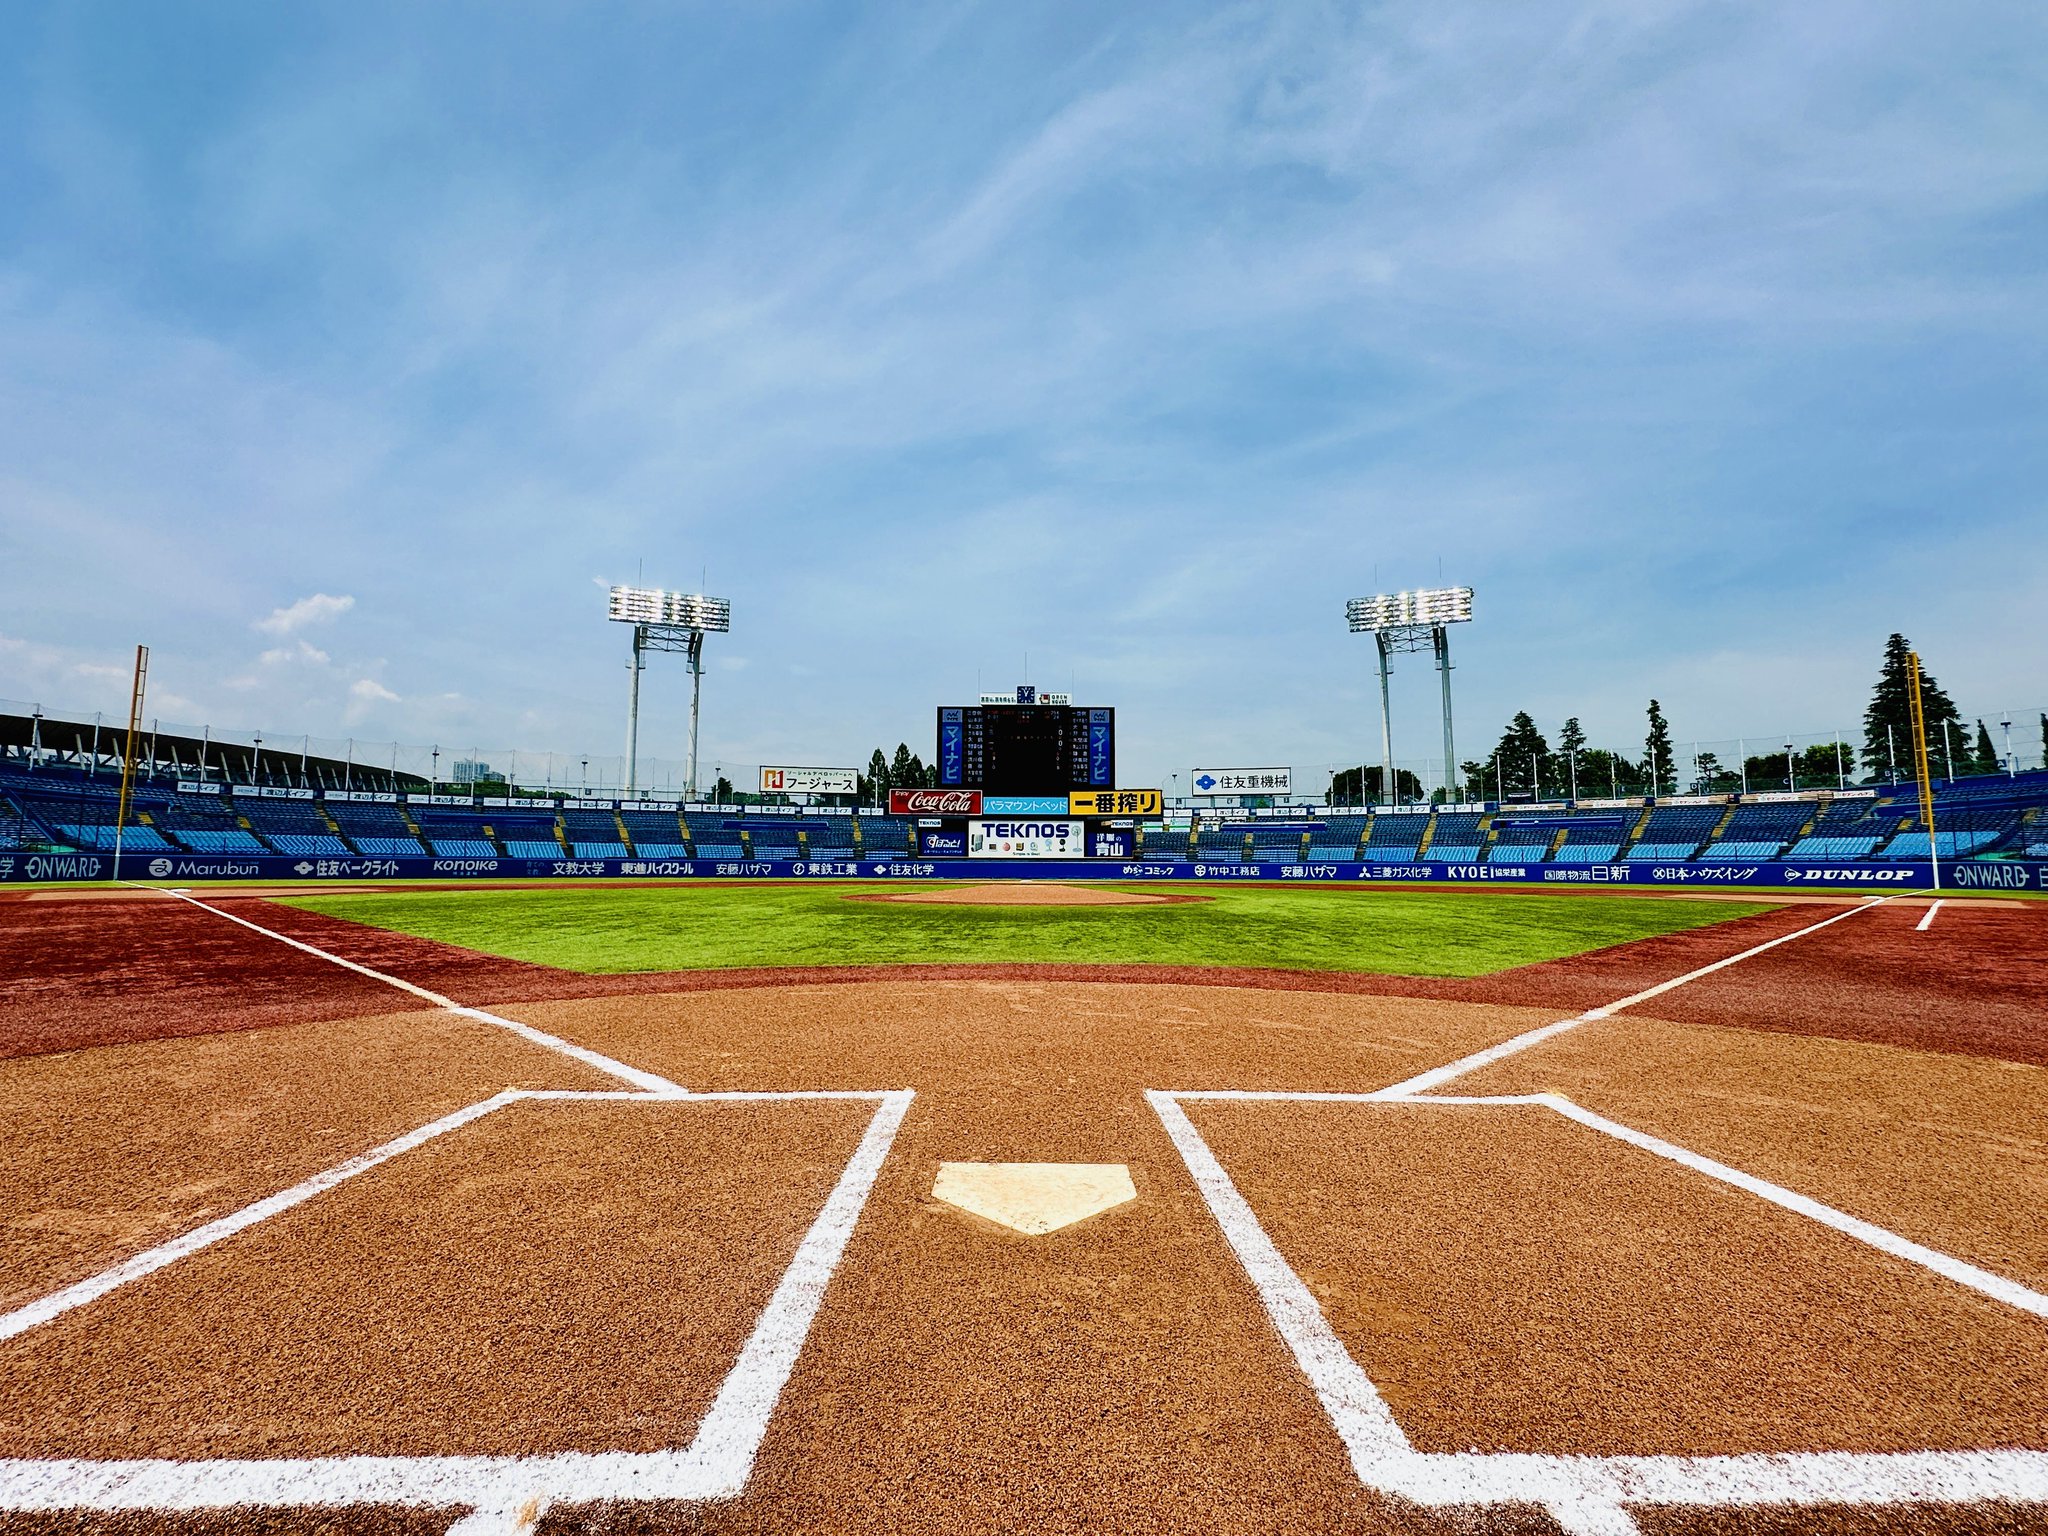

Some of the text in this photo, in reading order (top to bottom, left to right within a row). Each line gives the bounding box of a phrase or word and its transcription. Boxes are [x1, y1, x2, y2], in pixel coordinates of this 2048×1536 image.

[945, 726, 959, 779] マイナビ
[1092, 726, 1107, 780] マイナビ
[786, 777, 854, 791] フージャース
[1220, 775, 1288, 789] 住友重機械
[907, 791, 973, 811] Coca-Cola
[984, 800, 1067, 812] パラマウントベッド
[1074, 793, 1156, 813] 一番搾り
[981, 823, 1070, 838] TEKNOS
[1095, 842, 1124, 856] 青山
[24, 856, 102, 879] ONWARD
[176, 860, 260, 875] Marubun
[316, 860, 400, 876] 住友ベークライト
[552, 862, 605, 875] 文教大学
[620, 862, 694, 875] 東進ハイスクール
[715, 863, 772, 876] 安藤ハザマ
[808, 863, 858, 875] 東鉄工業
[889, 863, 935, 875] 住友化学
[1208, 866, 1260, 876] 竹中工務店
[1281, 866, 1337, 877] 安藤ハザマ
[1372, 867, 1432, 878] 三菱ガス化学
[1592, 865, 1631, 880] 日新
[1666, 867, 1759, 880] 日本ハウズイング
[1802, 870, 1914, 880] DUNLOP
[1953, 865, 2030, 887] ONWARD
